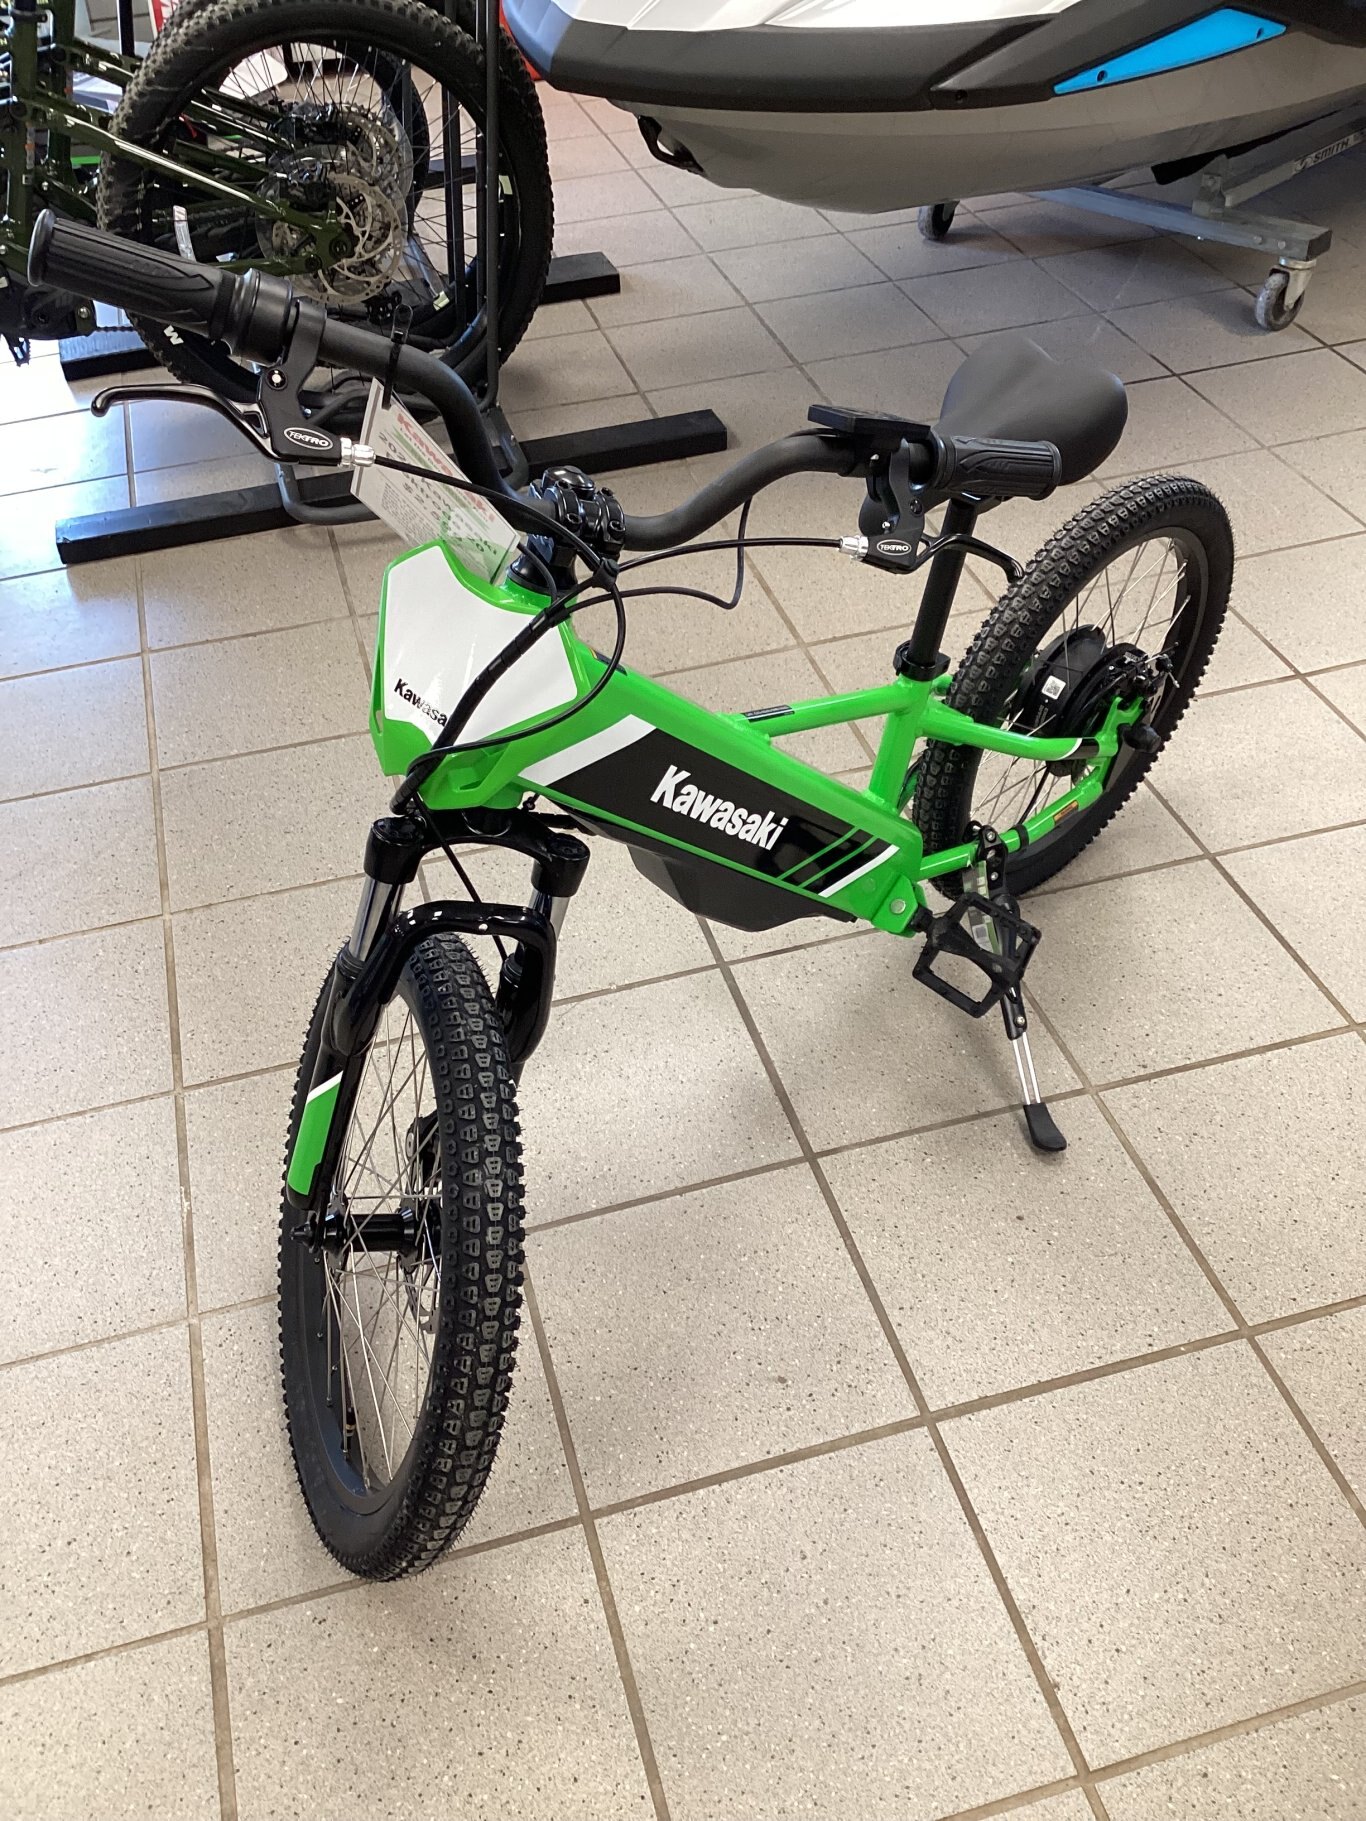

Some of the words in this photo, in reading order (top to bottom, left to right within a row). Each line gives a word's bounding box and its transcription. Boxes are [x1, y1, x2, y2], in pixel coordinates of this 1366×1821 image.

[1314, 138, 1350, 162] SMITH
[289, 430, 329, 447] TEKTRO
[397, 413, 496, 523] Kawaaki
[879, 544, 909, 552] TEKTRO
[394, 678, 449, 727] Kawasa
[650, 764, 789, 851] Kawasaki
